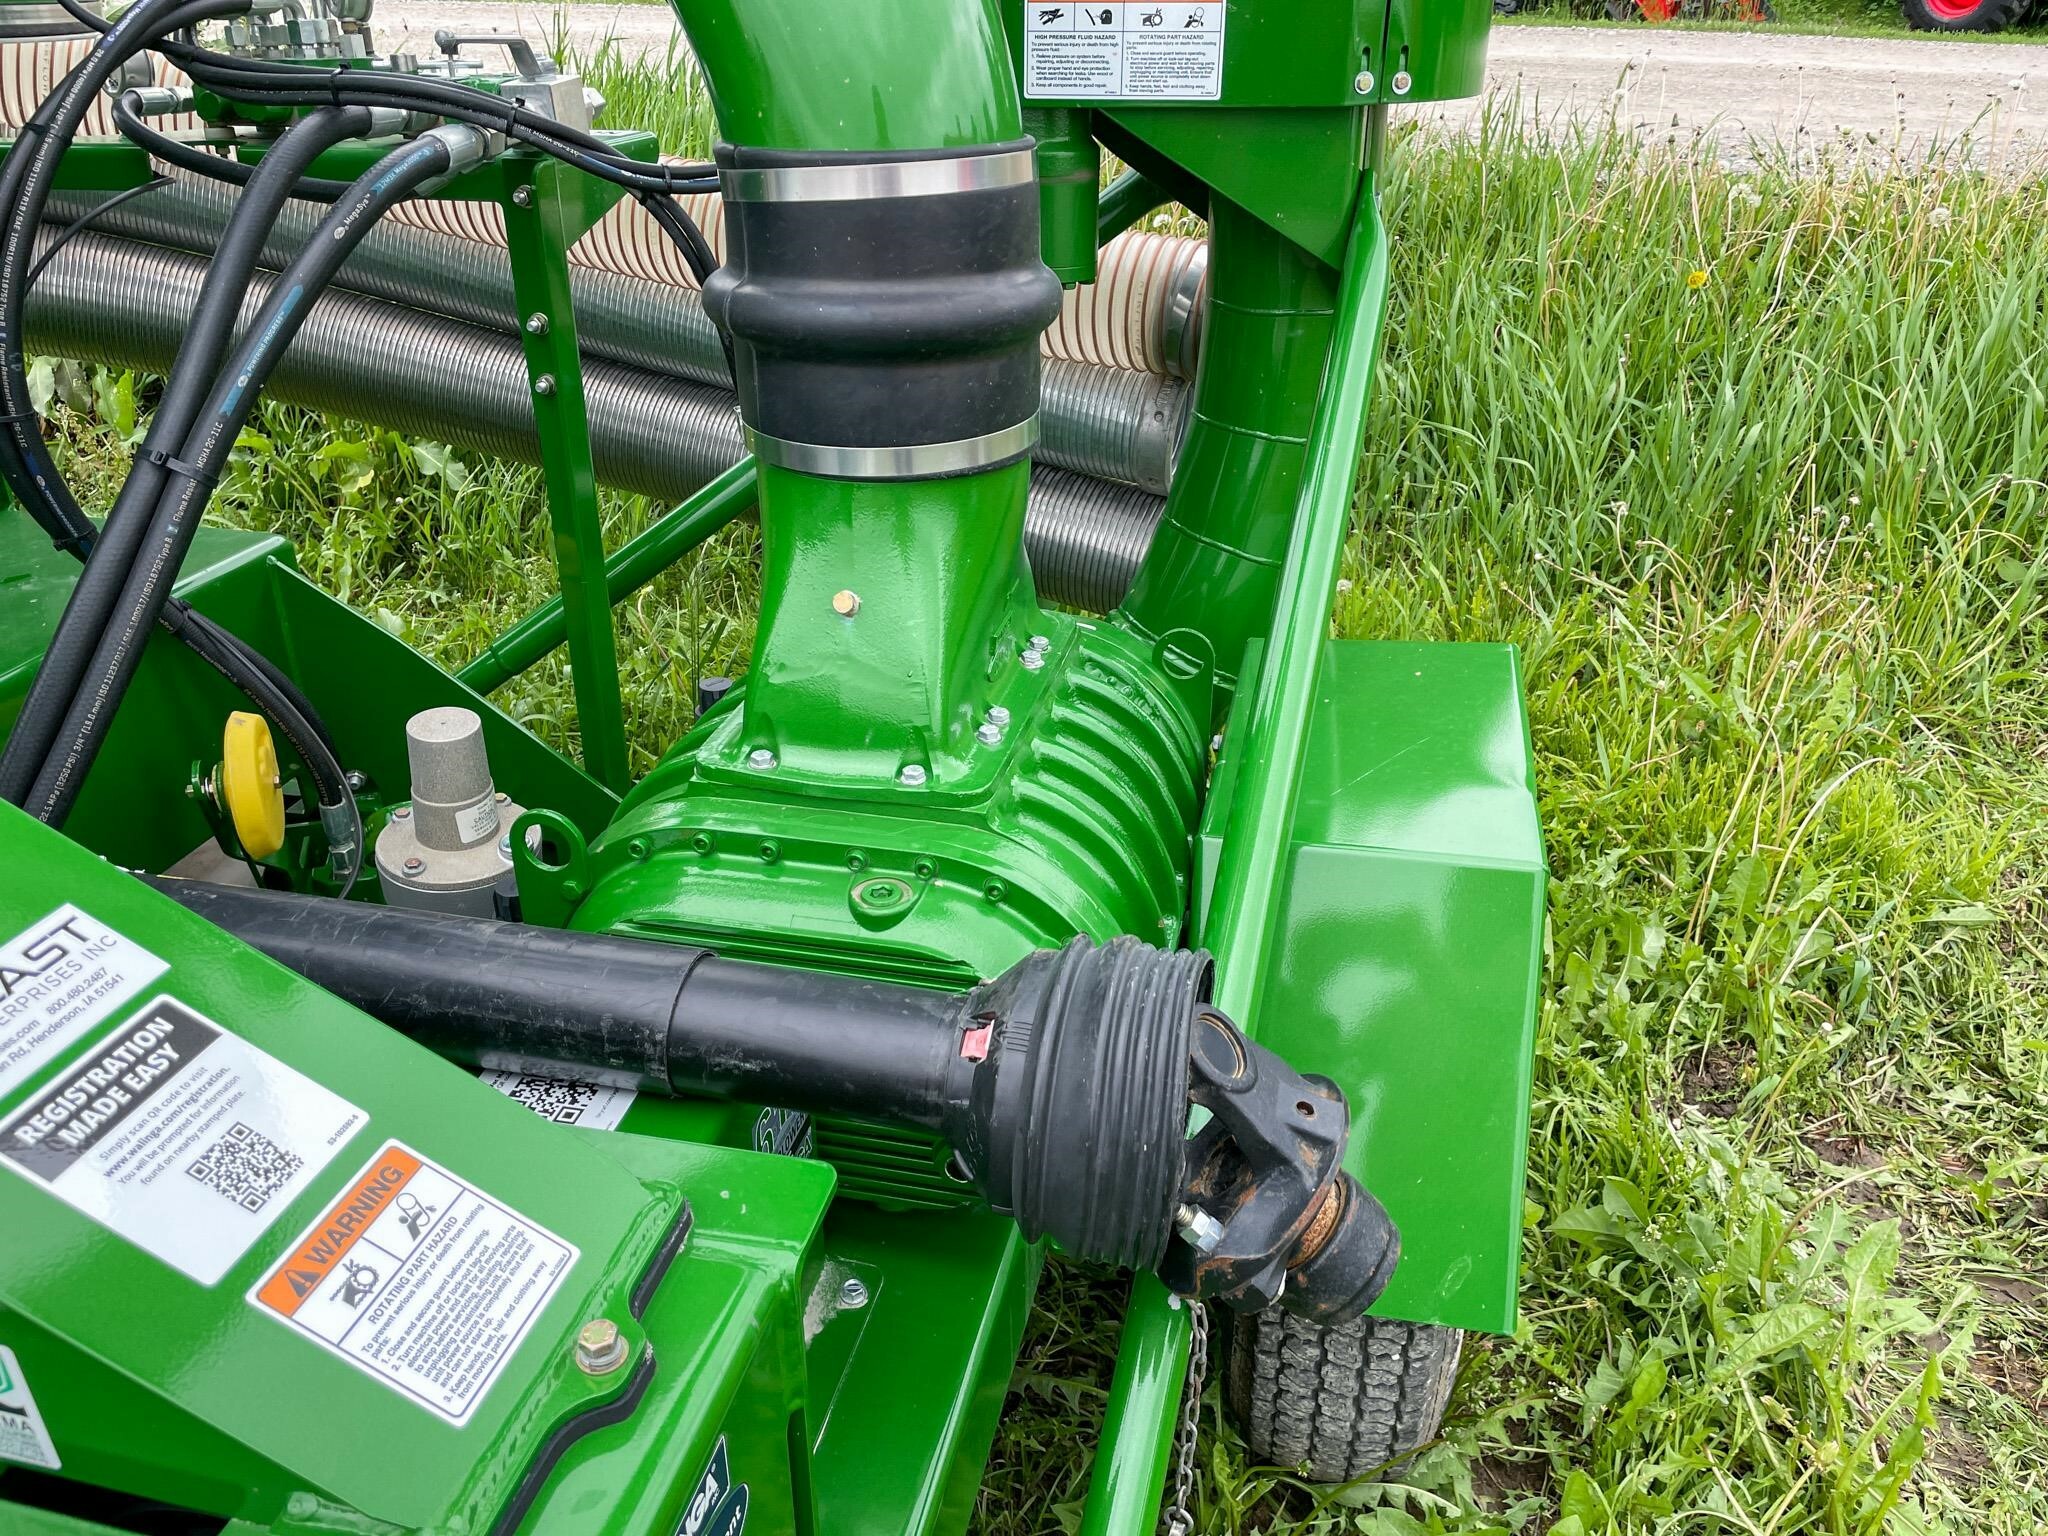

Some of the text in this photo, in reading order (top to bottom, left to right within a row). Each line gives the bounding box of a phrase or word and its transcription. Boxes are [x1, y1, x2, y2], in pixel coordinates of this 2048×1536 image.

[39, 805, 53, 823] 22.5
[46, 788, 61, 808] MPa
[105, 659, 122, 685] 11237
[149, 559, 165, 585] 18752
[46, 967, 108, 1015] 800.480.2487
[81, 935, 117, 961] INC
[28, 1004, 86, 1047] Henderson,
[94, 973, 125, 998] 51541
[14, 1016, 174, 1146] REGISTRATION
[57, 1042, 180, 1148] MADE EASY
[98, 1066, 208, 1161] Simply scan QR code to visit
[101, 1064, 232, 1179] www.walinga.com/registration.
[118, 1074, 241, 1185] You will be prompted for information
[139, 1088, 248, 1185] found on nearby stamped plate.
[303, 1162, 405, 1268] WARNING
[367, 1215, 458, 1324] ROTATING PART HAZARD
[361, 1202, 485, 1354] To prevent serious injury or death from rotating
[386, 1334, 407, 1357] Close
[403, 1321, 418, 1336] and
[414, 1298, 435, 1322] secure
[431, 1278, 452, 1300] guard
[446, 1257, 466, 1280] before
[462, 1227, 491, 1260] operating.
[397, 1344, 415, 1363] Turn
[411, 1313, 438, 1345] machine
[434, 1303, 446, 1315] off
[443, 1295, 452, 1304] or
[448, 1267, 473, 1296] lock-out
[469, 1244, 491, 1270] tag-out
[405, 1224, 518, 1368] electrical power and wait for all moving parts
[414, 1227, 526, 1373] to stop before servicing, adjusting, repairing,
[422, 1236, 529, 1379] unplugging or maintaining unit. Ensure that
[430, 1242, 535, 1383] unit power source is completely shut down
[449, 1372, 469, 1395] Keep
[463, 1348, 486, 1375] hands,
[480, 1331, 497, 1350] feet,
[492, 1317, 506, 1333] hair
[502, 1303, 516, 1319] and
[512, 1277, 536, 1306] clothing
[532, 1260, 548, 1279] away
[370, 1335, 393, 1360] parts:
[438, 1315, 496, 1388] and can not start up.
[457, 1331, 509, 1399] from moving parts.
